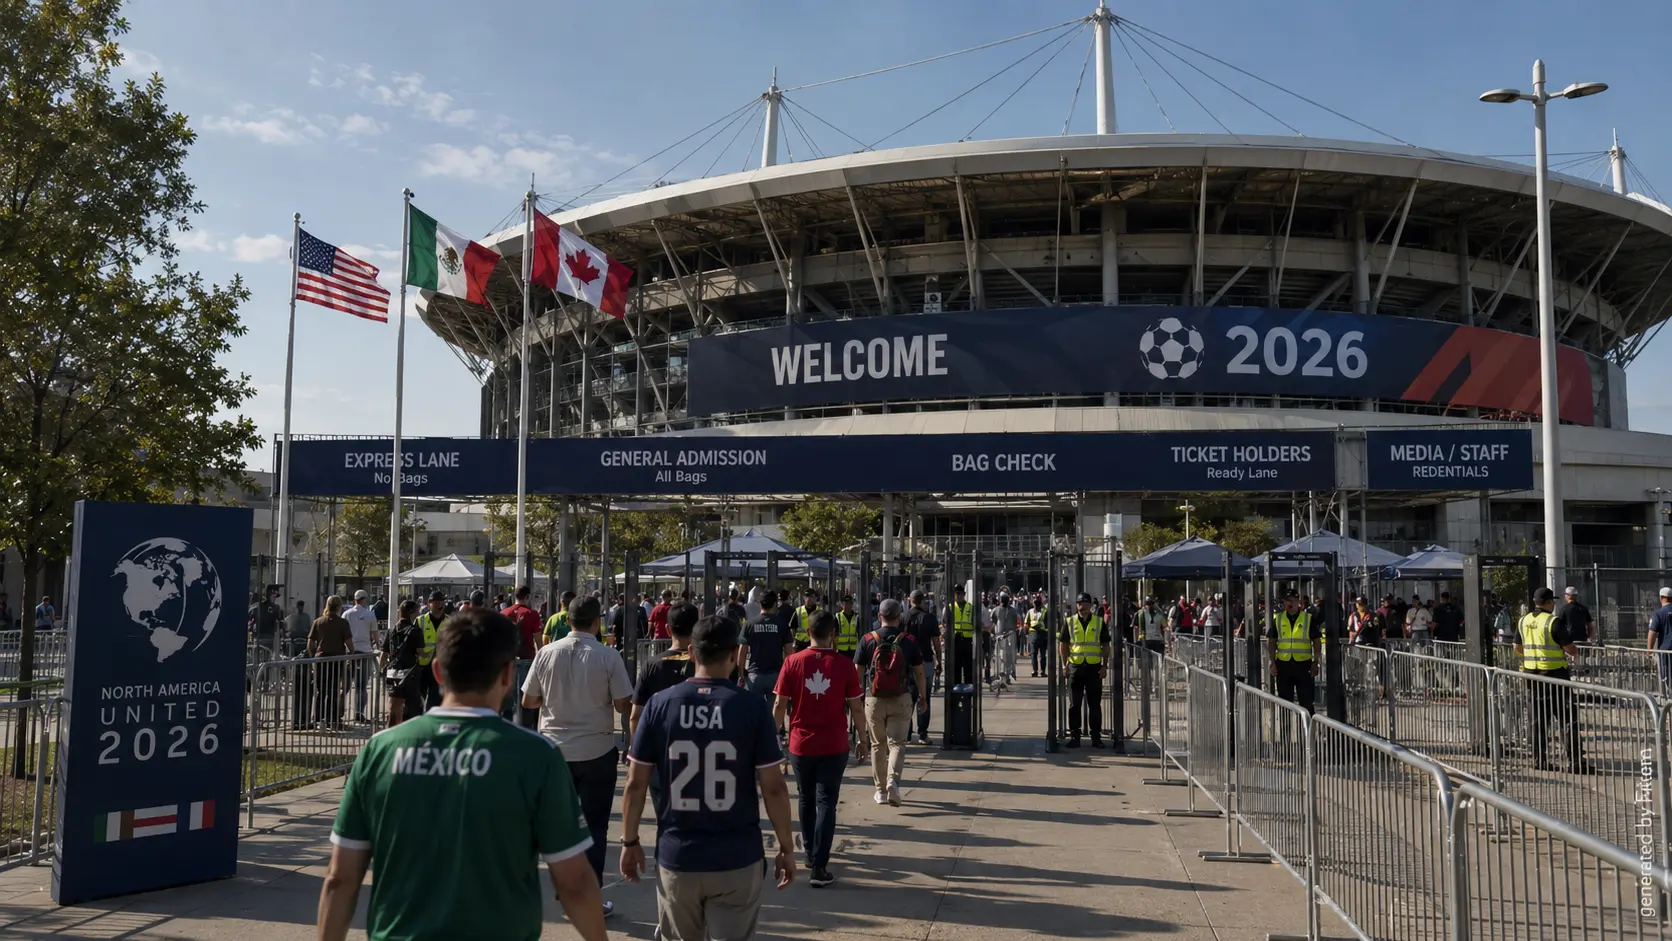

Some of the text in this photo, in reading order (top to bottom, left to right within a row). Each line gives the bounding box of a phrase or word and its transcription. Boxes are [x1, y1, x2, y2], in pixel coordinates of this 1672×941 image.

[771, 326, 1368, 386] WELCOME 2026
[419, 452, 460, 467] LANE
[600, 449, 767, 467] GENERAL ADMISSION
[1170, 446, 1311, 463] TICKET HOLDERS
[1390, 444, 1509, 462] MEDIA / STAFF
[952, 453, 1057, 472] BAG CHECK
[1412, 465, 1489, 478] REDENTIALS
[374, 472, 391, 484] No
[655, 470, 707, 485] All Bags
[1207, 466, 1278, 481] Ready Lane
[101, 681, 221, 700] NORTH AMERICA
[101, 700, 220, 725] UNITED
[680, 704, 724, 730] USA
[98, 723, 219, 765] 2026
[391, 741, 491, 776] MÉXICO
[668, 740, 738, 812] 26
